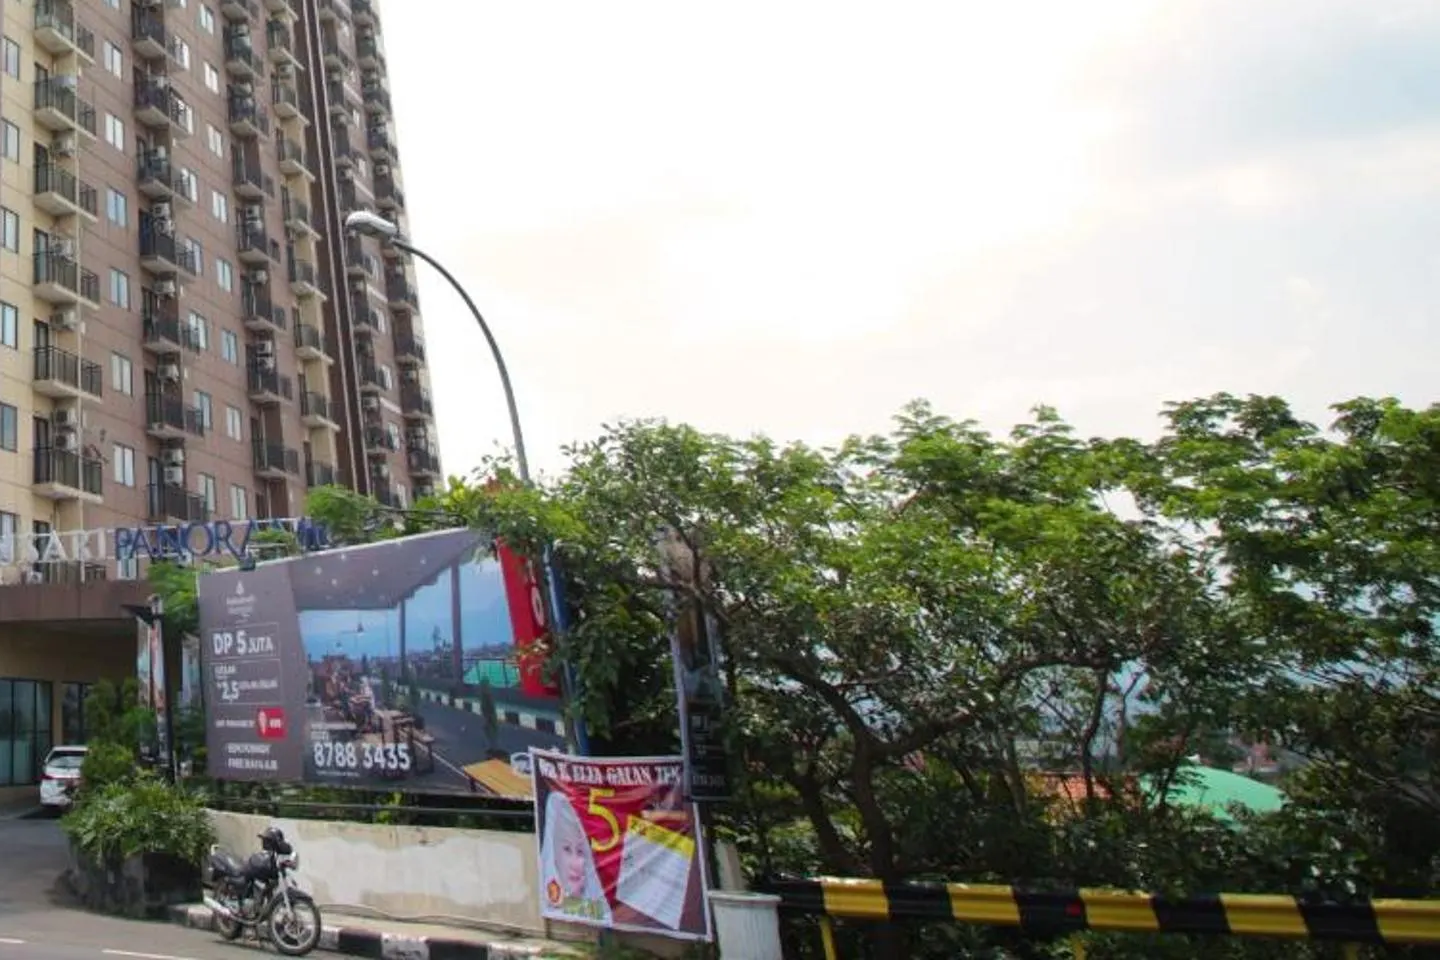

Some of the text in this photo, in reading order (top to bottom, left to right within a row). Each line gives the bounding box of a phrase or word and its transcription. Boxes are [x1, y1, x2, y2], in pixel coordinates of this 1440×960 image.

[213, 632, 234, 655] DP
[236, 630, 247, 656] 5
[313, 741, 411, 771] 8788 3435
[588, 787, 621, 852] 5
